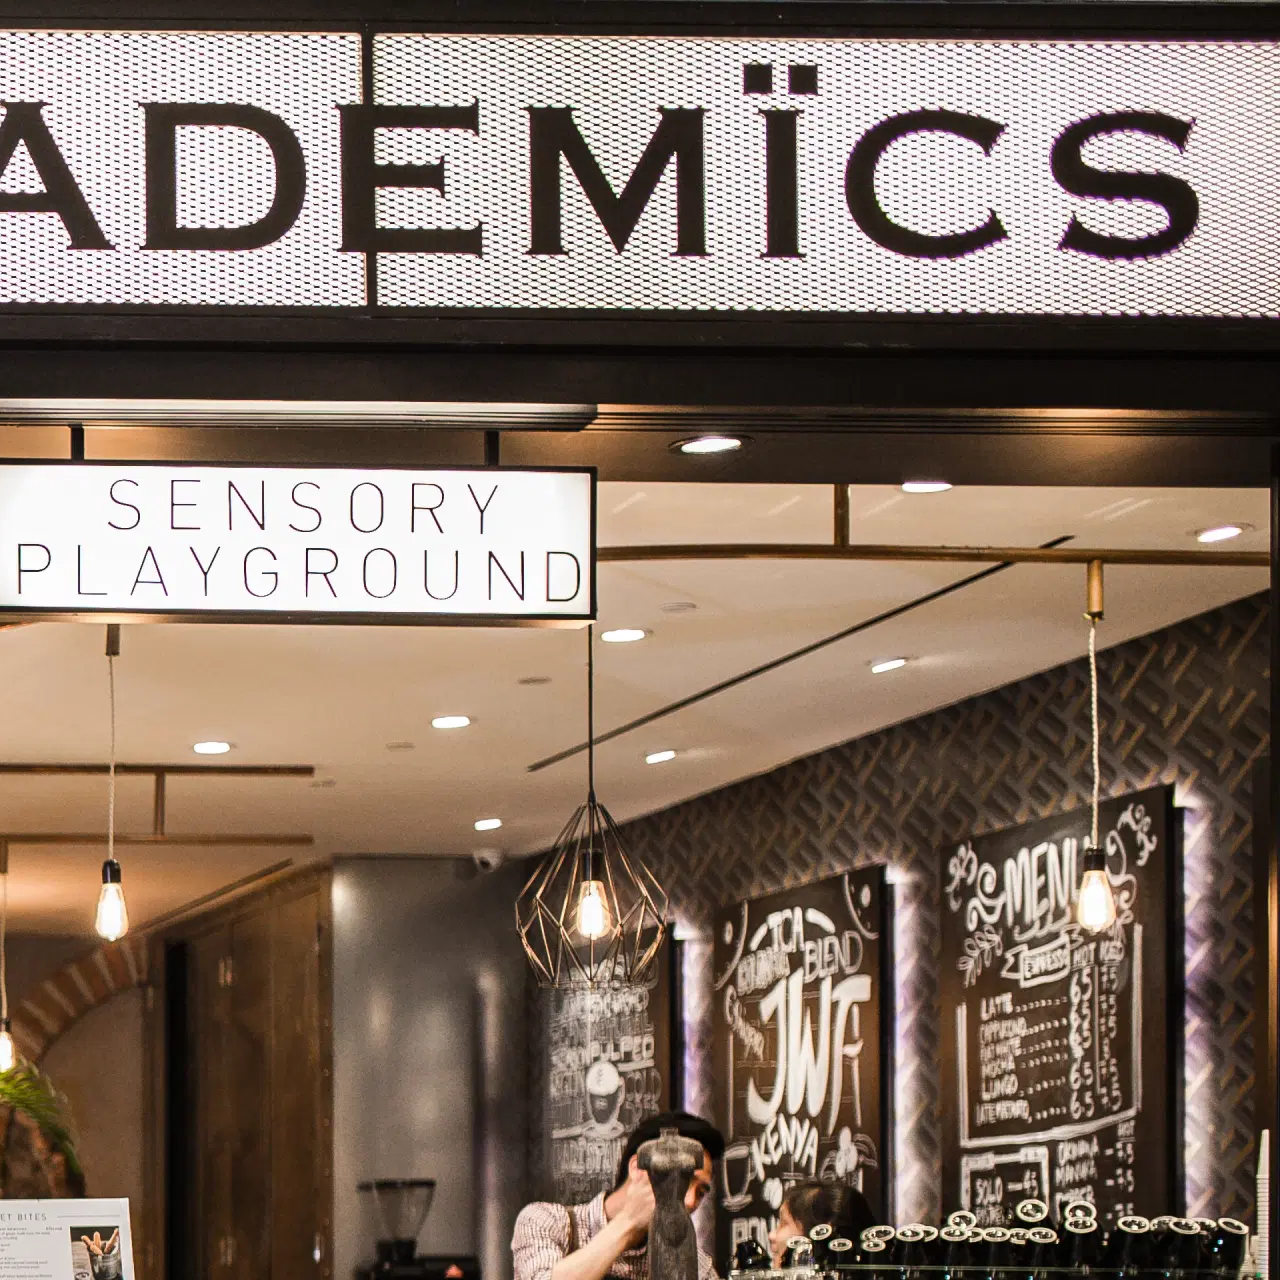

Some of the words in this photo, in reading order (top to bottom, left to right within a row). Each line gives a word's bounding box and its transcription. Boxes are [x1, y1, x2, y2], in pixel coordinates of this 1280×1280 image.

[107, 479, 498, 535] SENSORY
[17, 544, 581, 602] PLAYGROUND
[753, 1114, 818, 1181] KENYA
[18, 1212, 47, 1221] BITES
